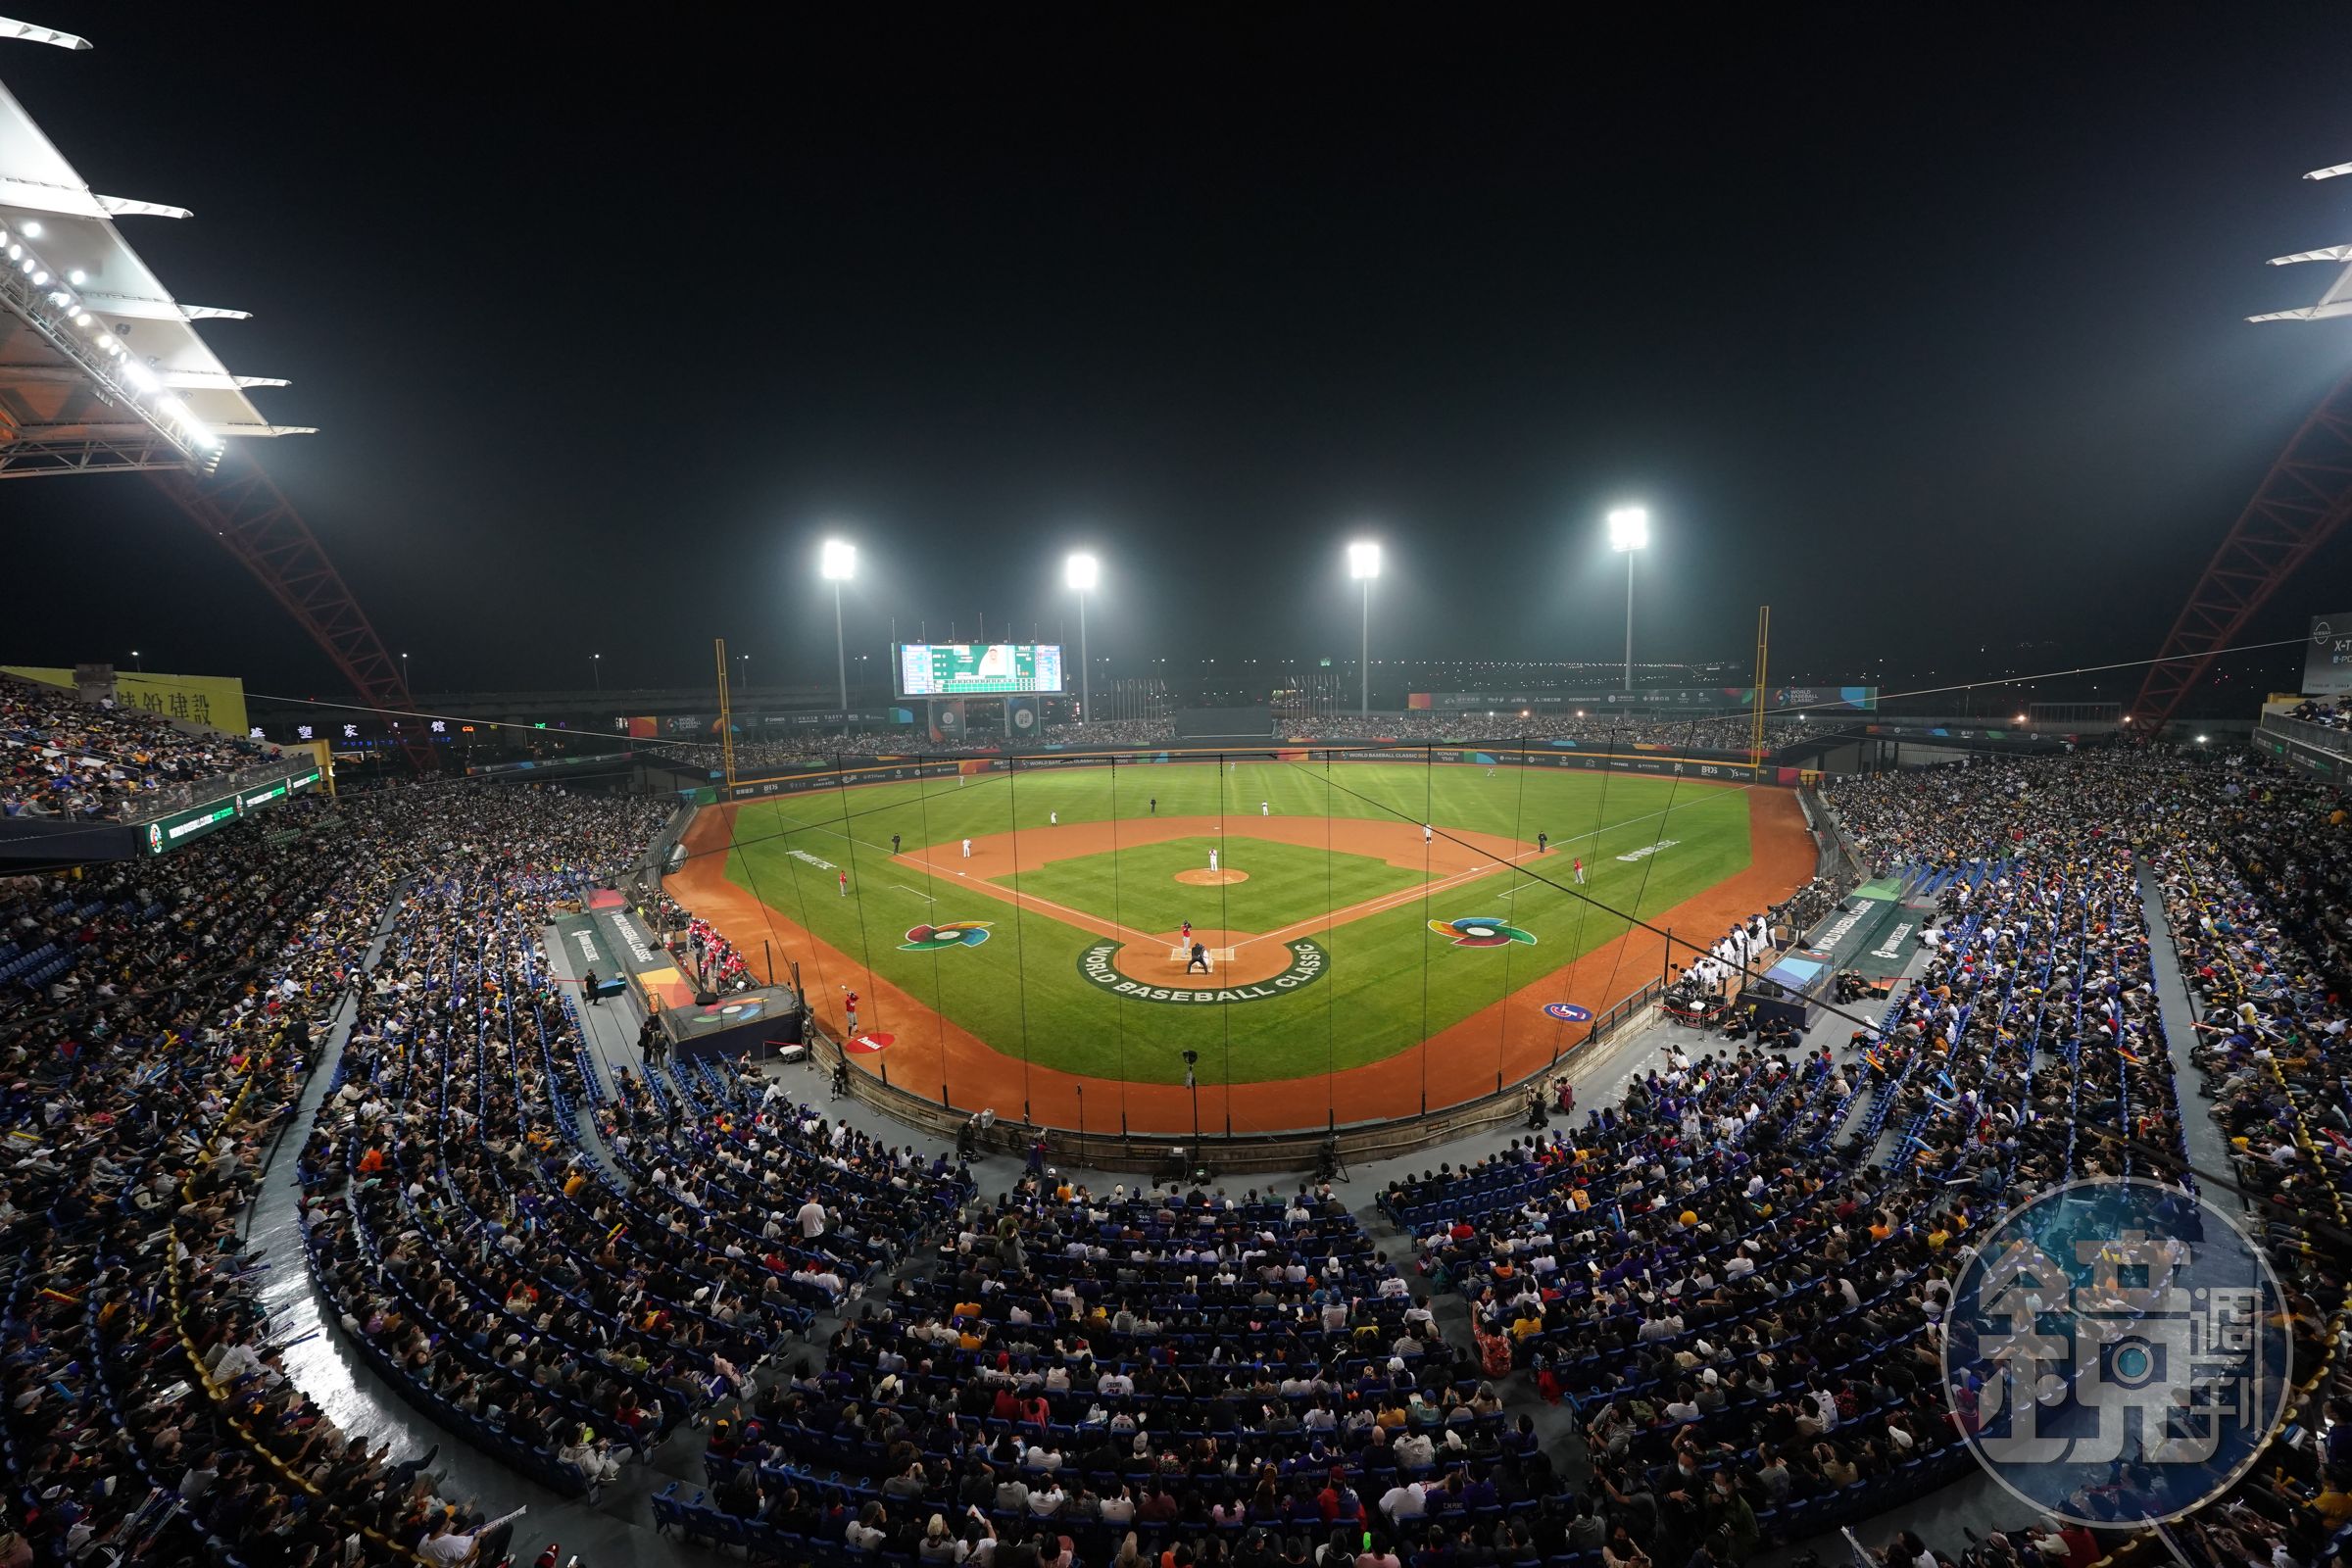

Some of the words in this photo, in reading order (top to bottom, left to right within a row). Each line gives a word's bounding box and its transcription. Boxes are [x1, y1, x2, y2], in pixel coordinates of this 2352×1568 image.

[2334, 639, 2352, 652] X-T
[1085, 946, 1117, 983] WORLD
[1113, 981, 1276, 1002] BASEBALL
[1275, 943, 1321, 988] CLASSIC
